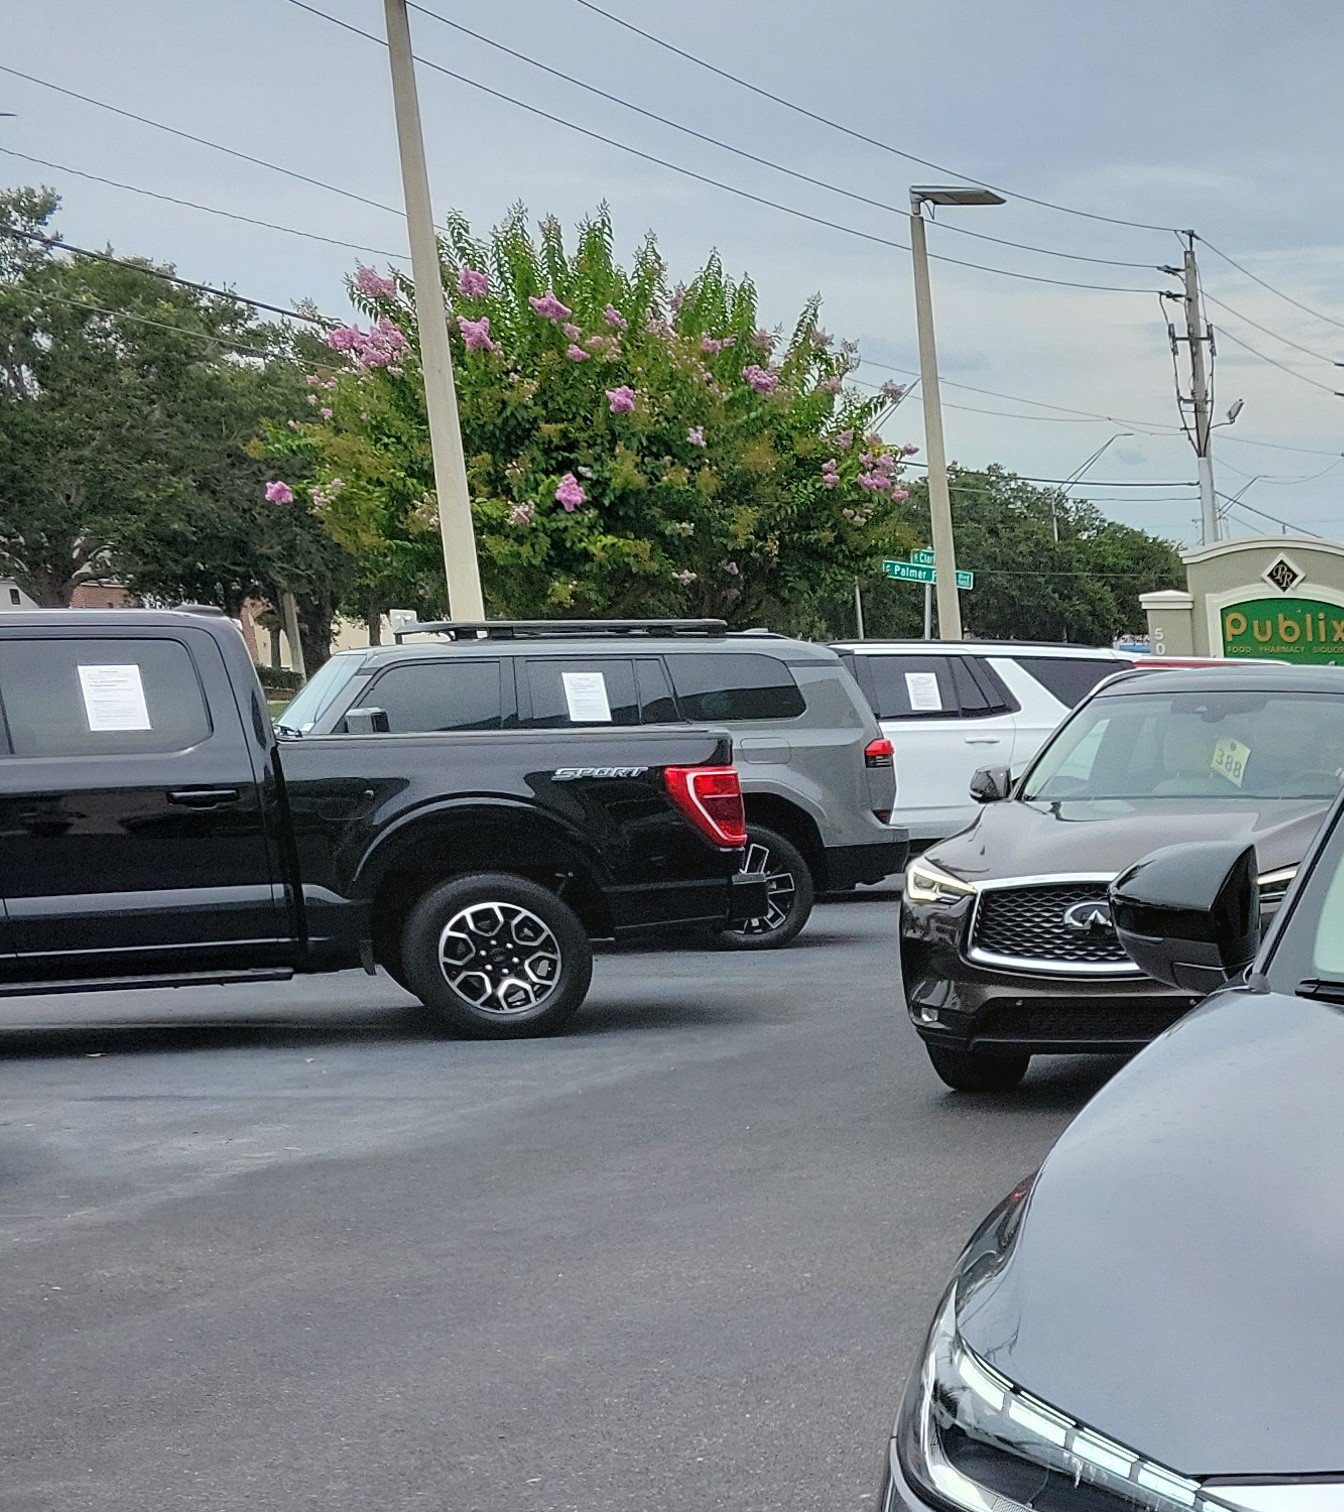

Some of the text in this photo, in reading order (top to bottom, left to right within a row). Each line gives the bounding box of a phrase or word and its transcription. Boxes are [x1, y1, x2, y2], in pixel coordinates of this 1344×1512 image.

[894, 564, 927, 579] Palmer
[1215, 749, 1242, 778] 388
[551, 766, 648, 780] SPORT
